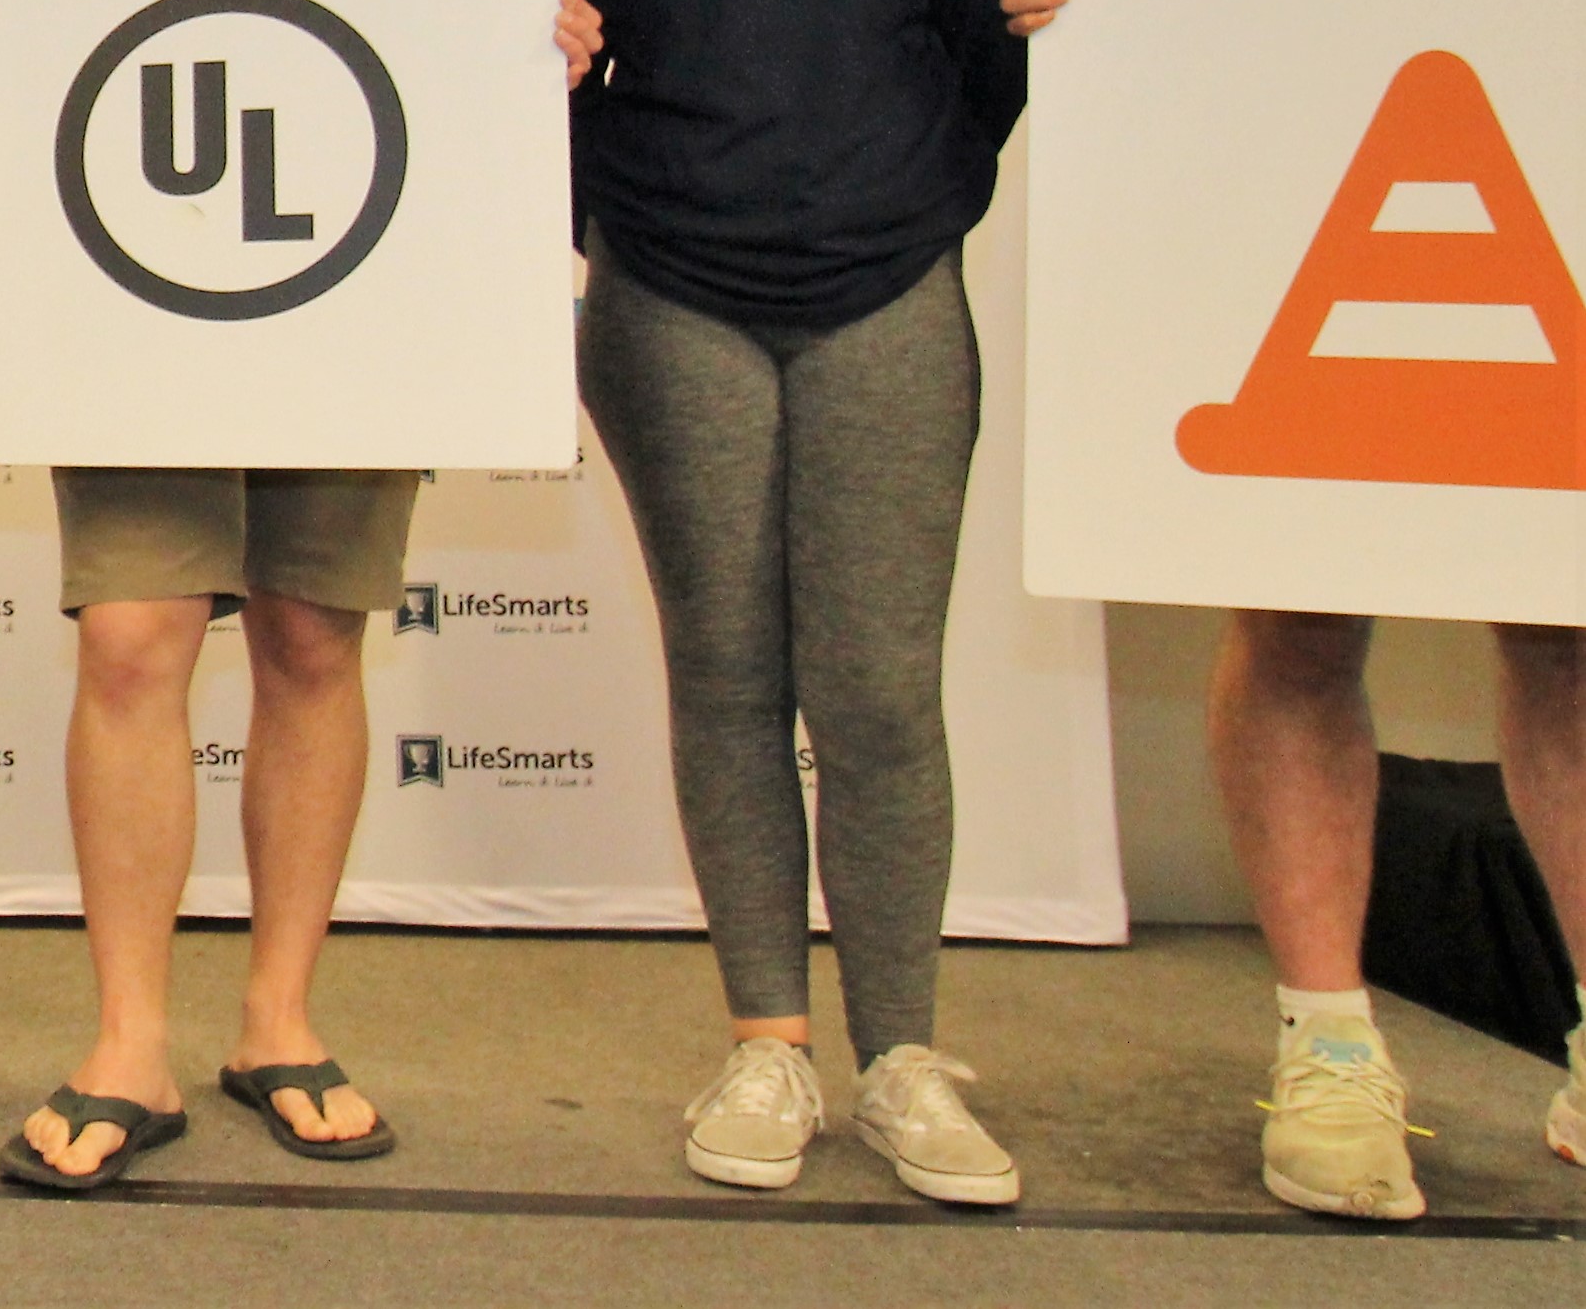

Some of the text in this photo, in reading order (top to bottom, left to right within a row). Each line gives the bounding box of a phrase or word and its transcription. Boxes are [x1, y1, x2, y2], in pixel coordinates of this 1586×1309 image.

[141, 60, 314, 243] UL
[443, 593, 588, 616] LifeSmarts
[448, 746, 593, 769] LifeSmarts
